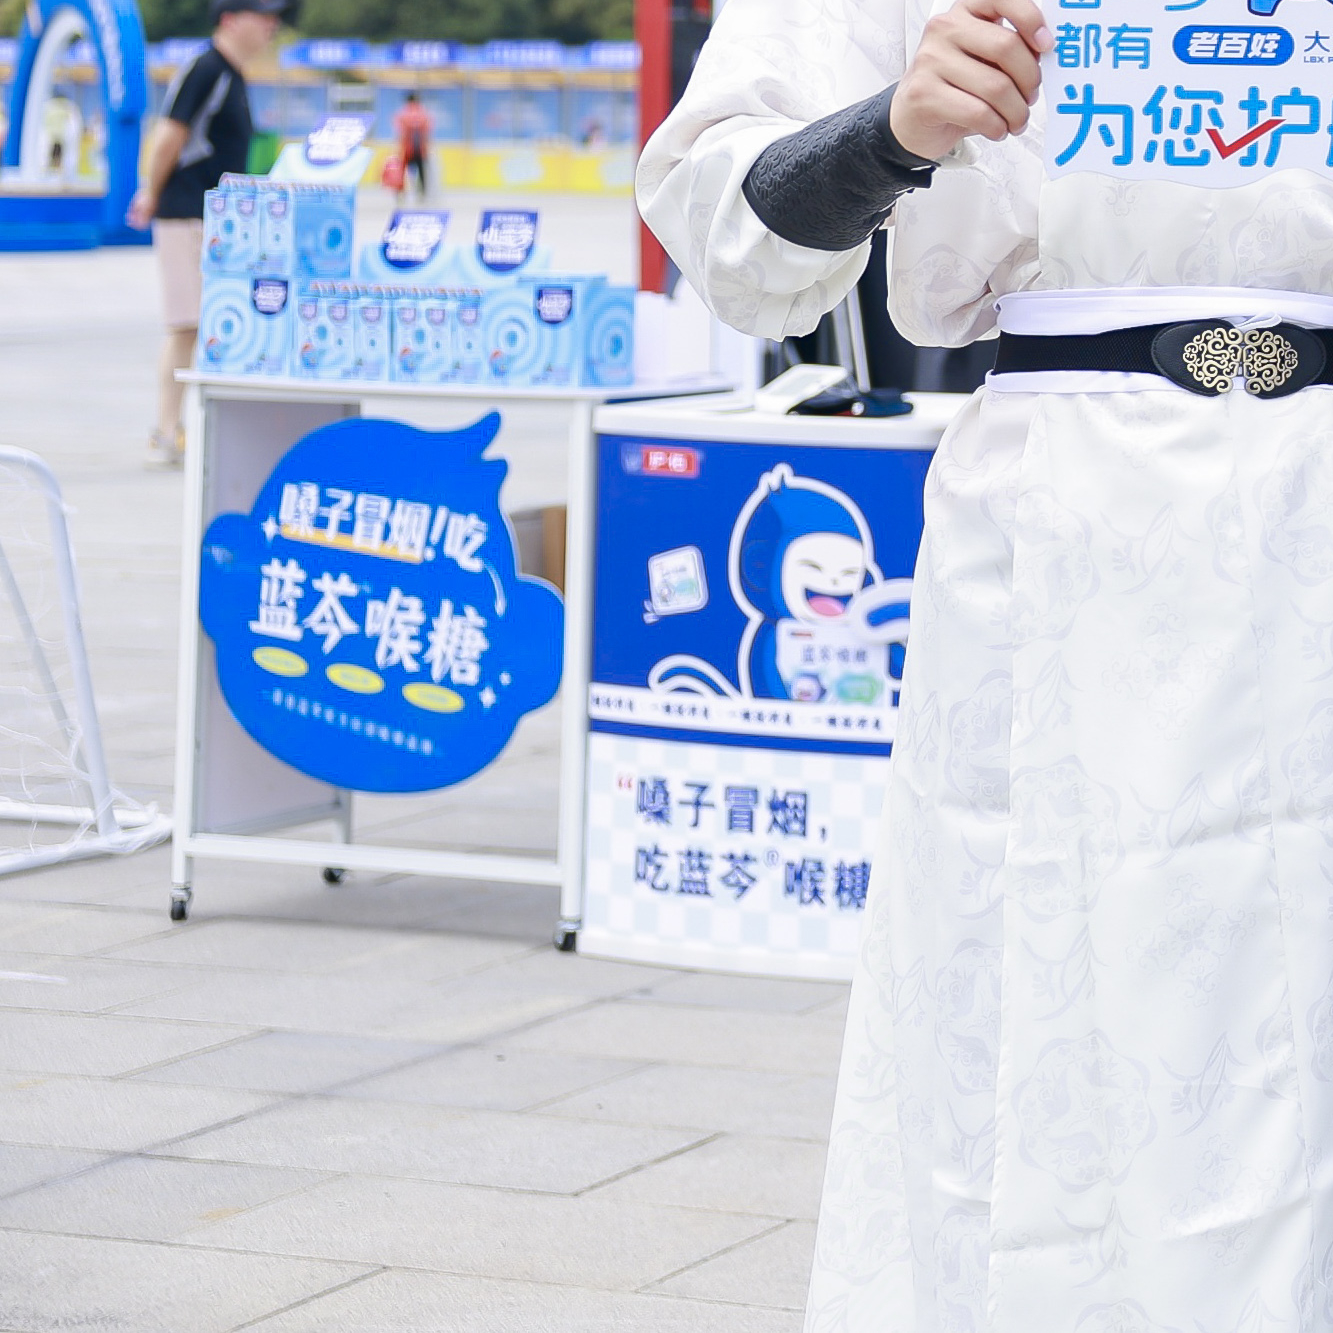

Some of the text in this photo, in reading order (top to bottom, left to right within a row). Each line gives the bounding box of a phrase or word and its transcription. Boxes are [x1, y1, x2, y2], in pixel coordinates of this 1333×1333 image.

[1053, 21, 1153, 69] 都有
[1185, 31, 1283, 60] 老百姓
[1303, 56, 1324, 65] LBX
